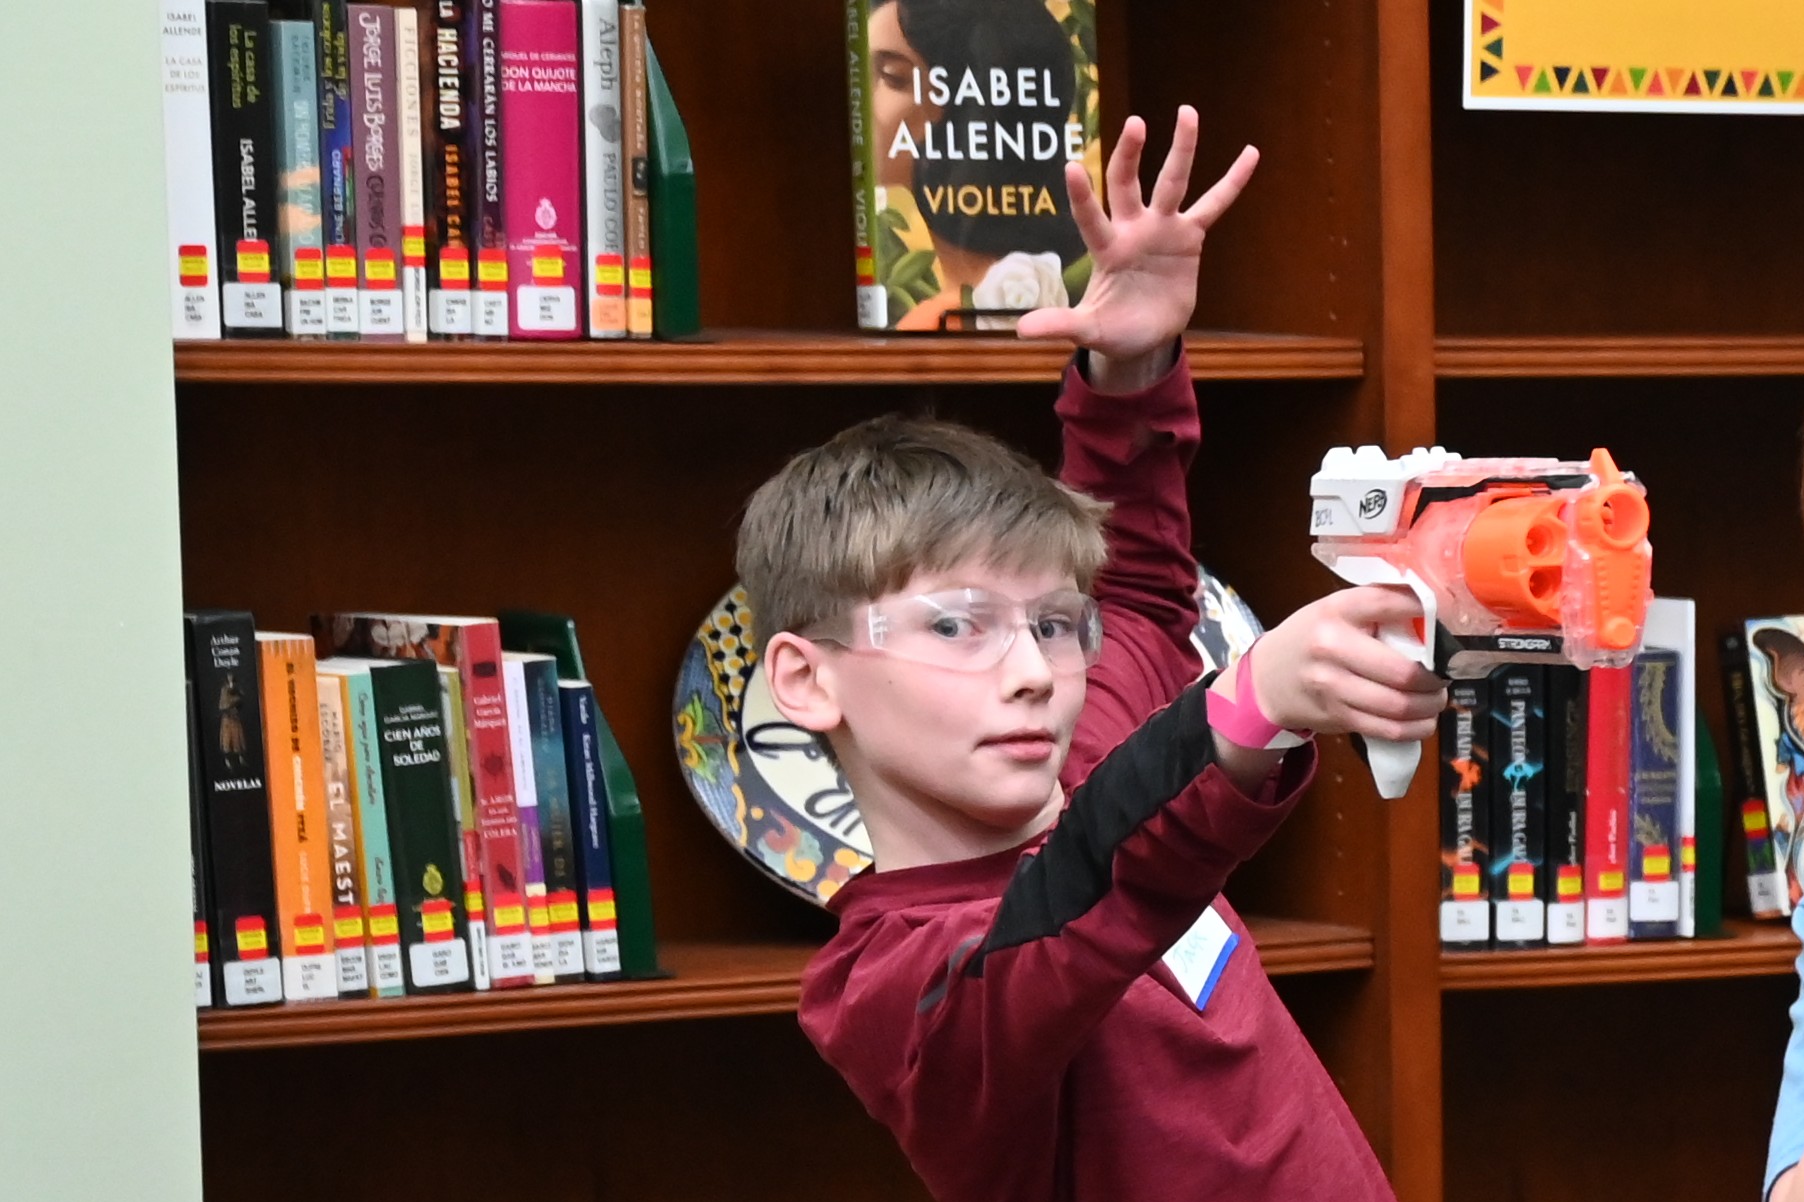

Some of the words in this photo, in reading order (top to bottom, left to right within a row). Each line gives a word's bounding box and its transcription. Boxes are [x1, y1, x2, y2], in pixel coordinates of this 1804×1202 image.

[483, 11, 496, 32] ME
[594, 18, 618, 91] Aleph
[436, 28, 462, 130] HACIENDA
[532, 67, 576, 81] QUIJOTE
[912, 66, 1061, 107] ISABEL
[849, 51, 864, 146] ALLENDE
[484, 118, 498, 147] LOS
[888, 118, 1084, 162] ALLENDE
[240, 138, 256, 191] ISABEL
[445, 144, 461, 207] ISABEL
[485, 150, 499, 203] LABIOS
[602, 153, 620, 212] PAULO
[923, 184, 1057, 217] VIOLETA
[384, 727, 412, 742] CIEN
[413, 724, 441, 739] AÑOS
[410, 740, 423, 752] DE
[393, 749, 441, 767] SOLEDAD
[213, 778, 263, 793] NOVELAS
[328, 782, 345, 811] EL
